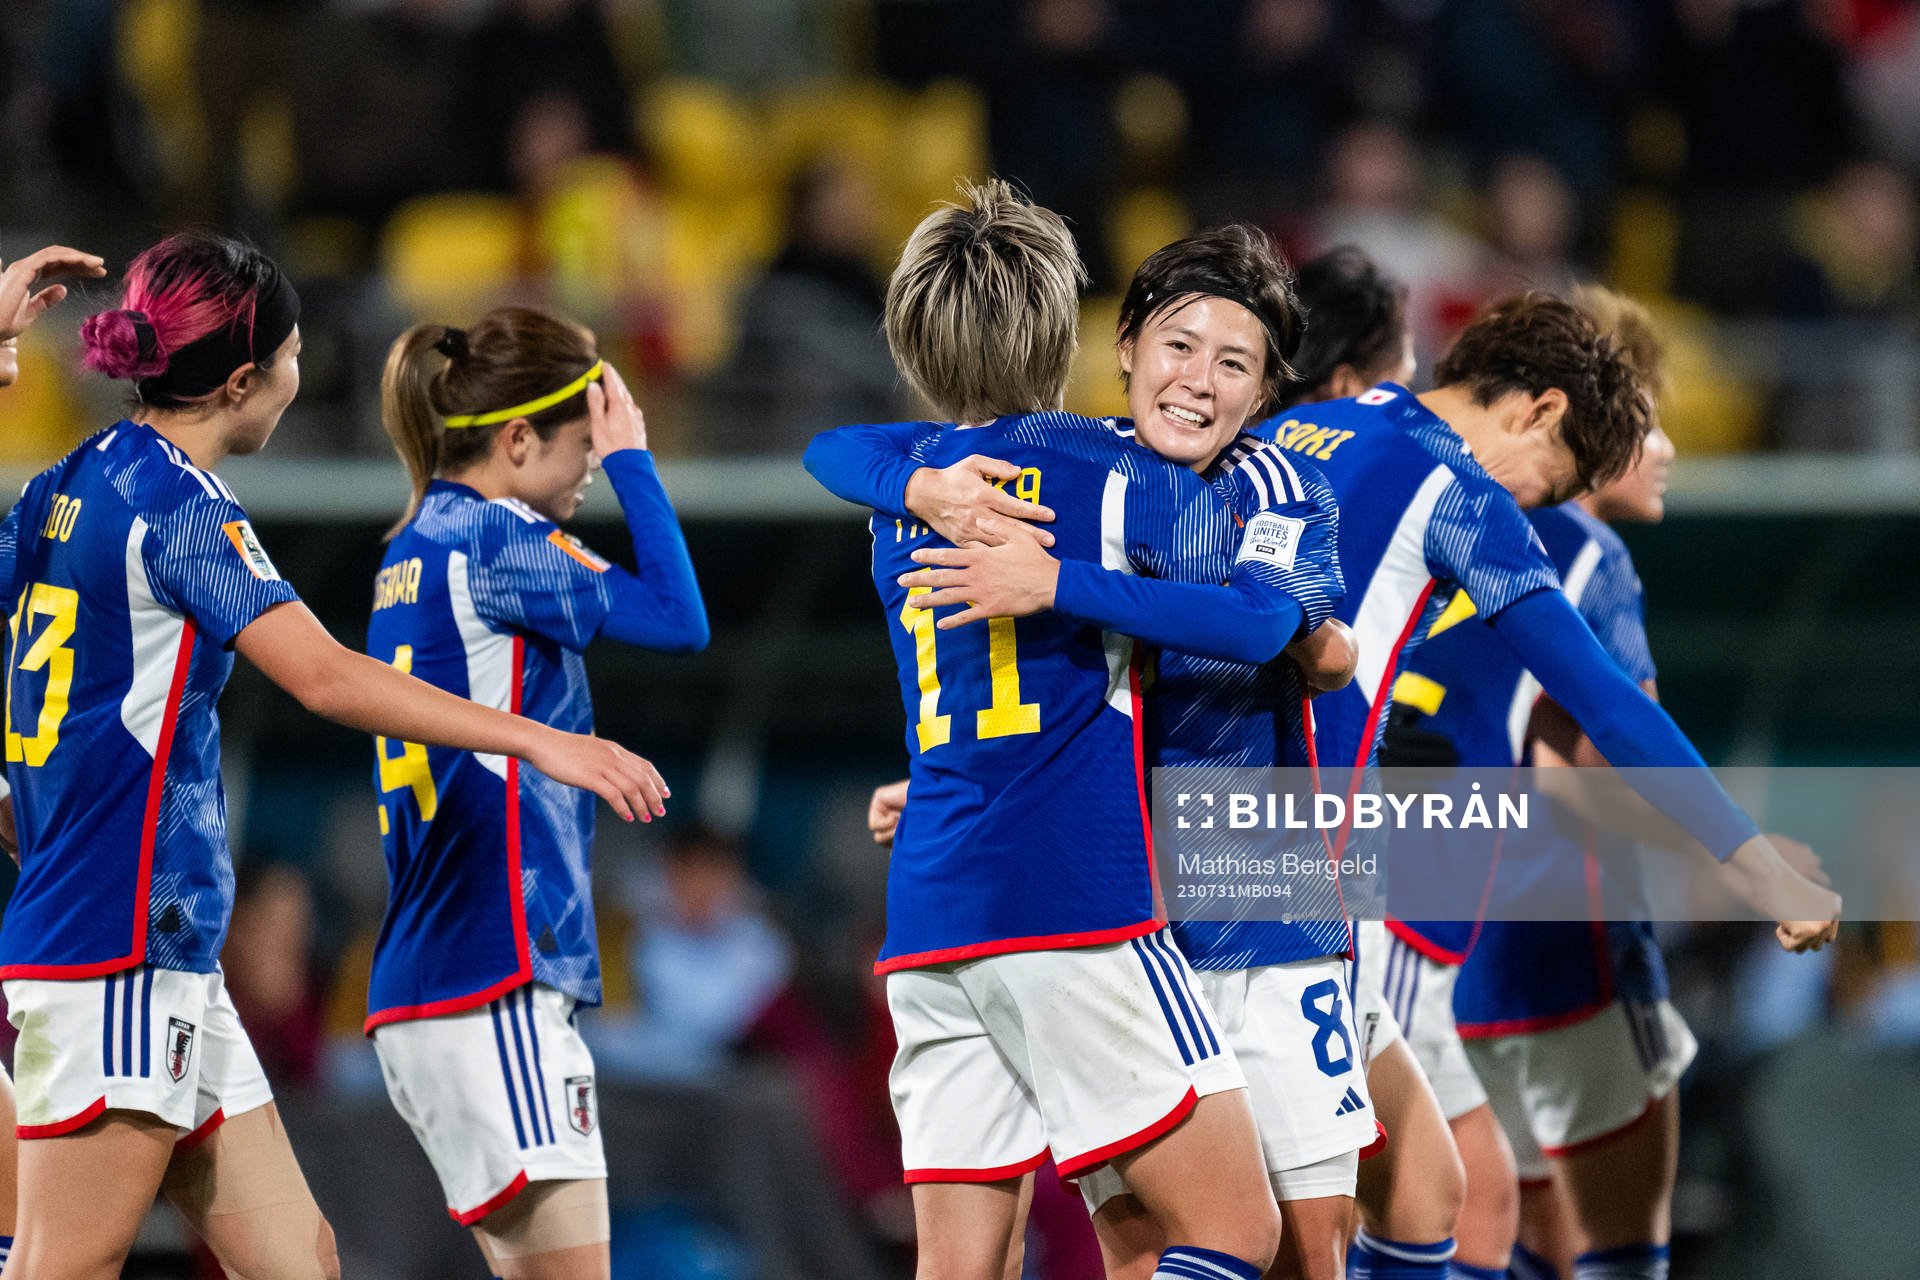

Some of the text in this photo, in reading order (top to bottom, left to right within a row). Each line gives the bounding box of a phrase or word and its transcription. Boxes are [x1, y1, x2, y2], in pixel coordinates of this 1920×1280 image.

[1275, 419, 1356, 460] SAKI
[1253, 527, 1289, 540] UNITES
[1255, 520, 1289, 530] FOOTBALL
[5, 582, 79, 767] 13
[900, 567, 1041, 755] 11
[1300, 978, 1353, 1078] 8
